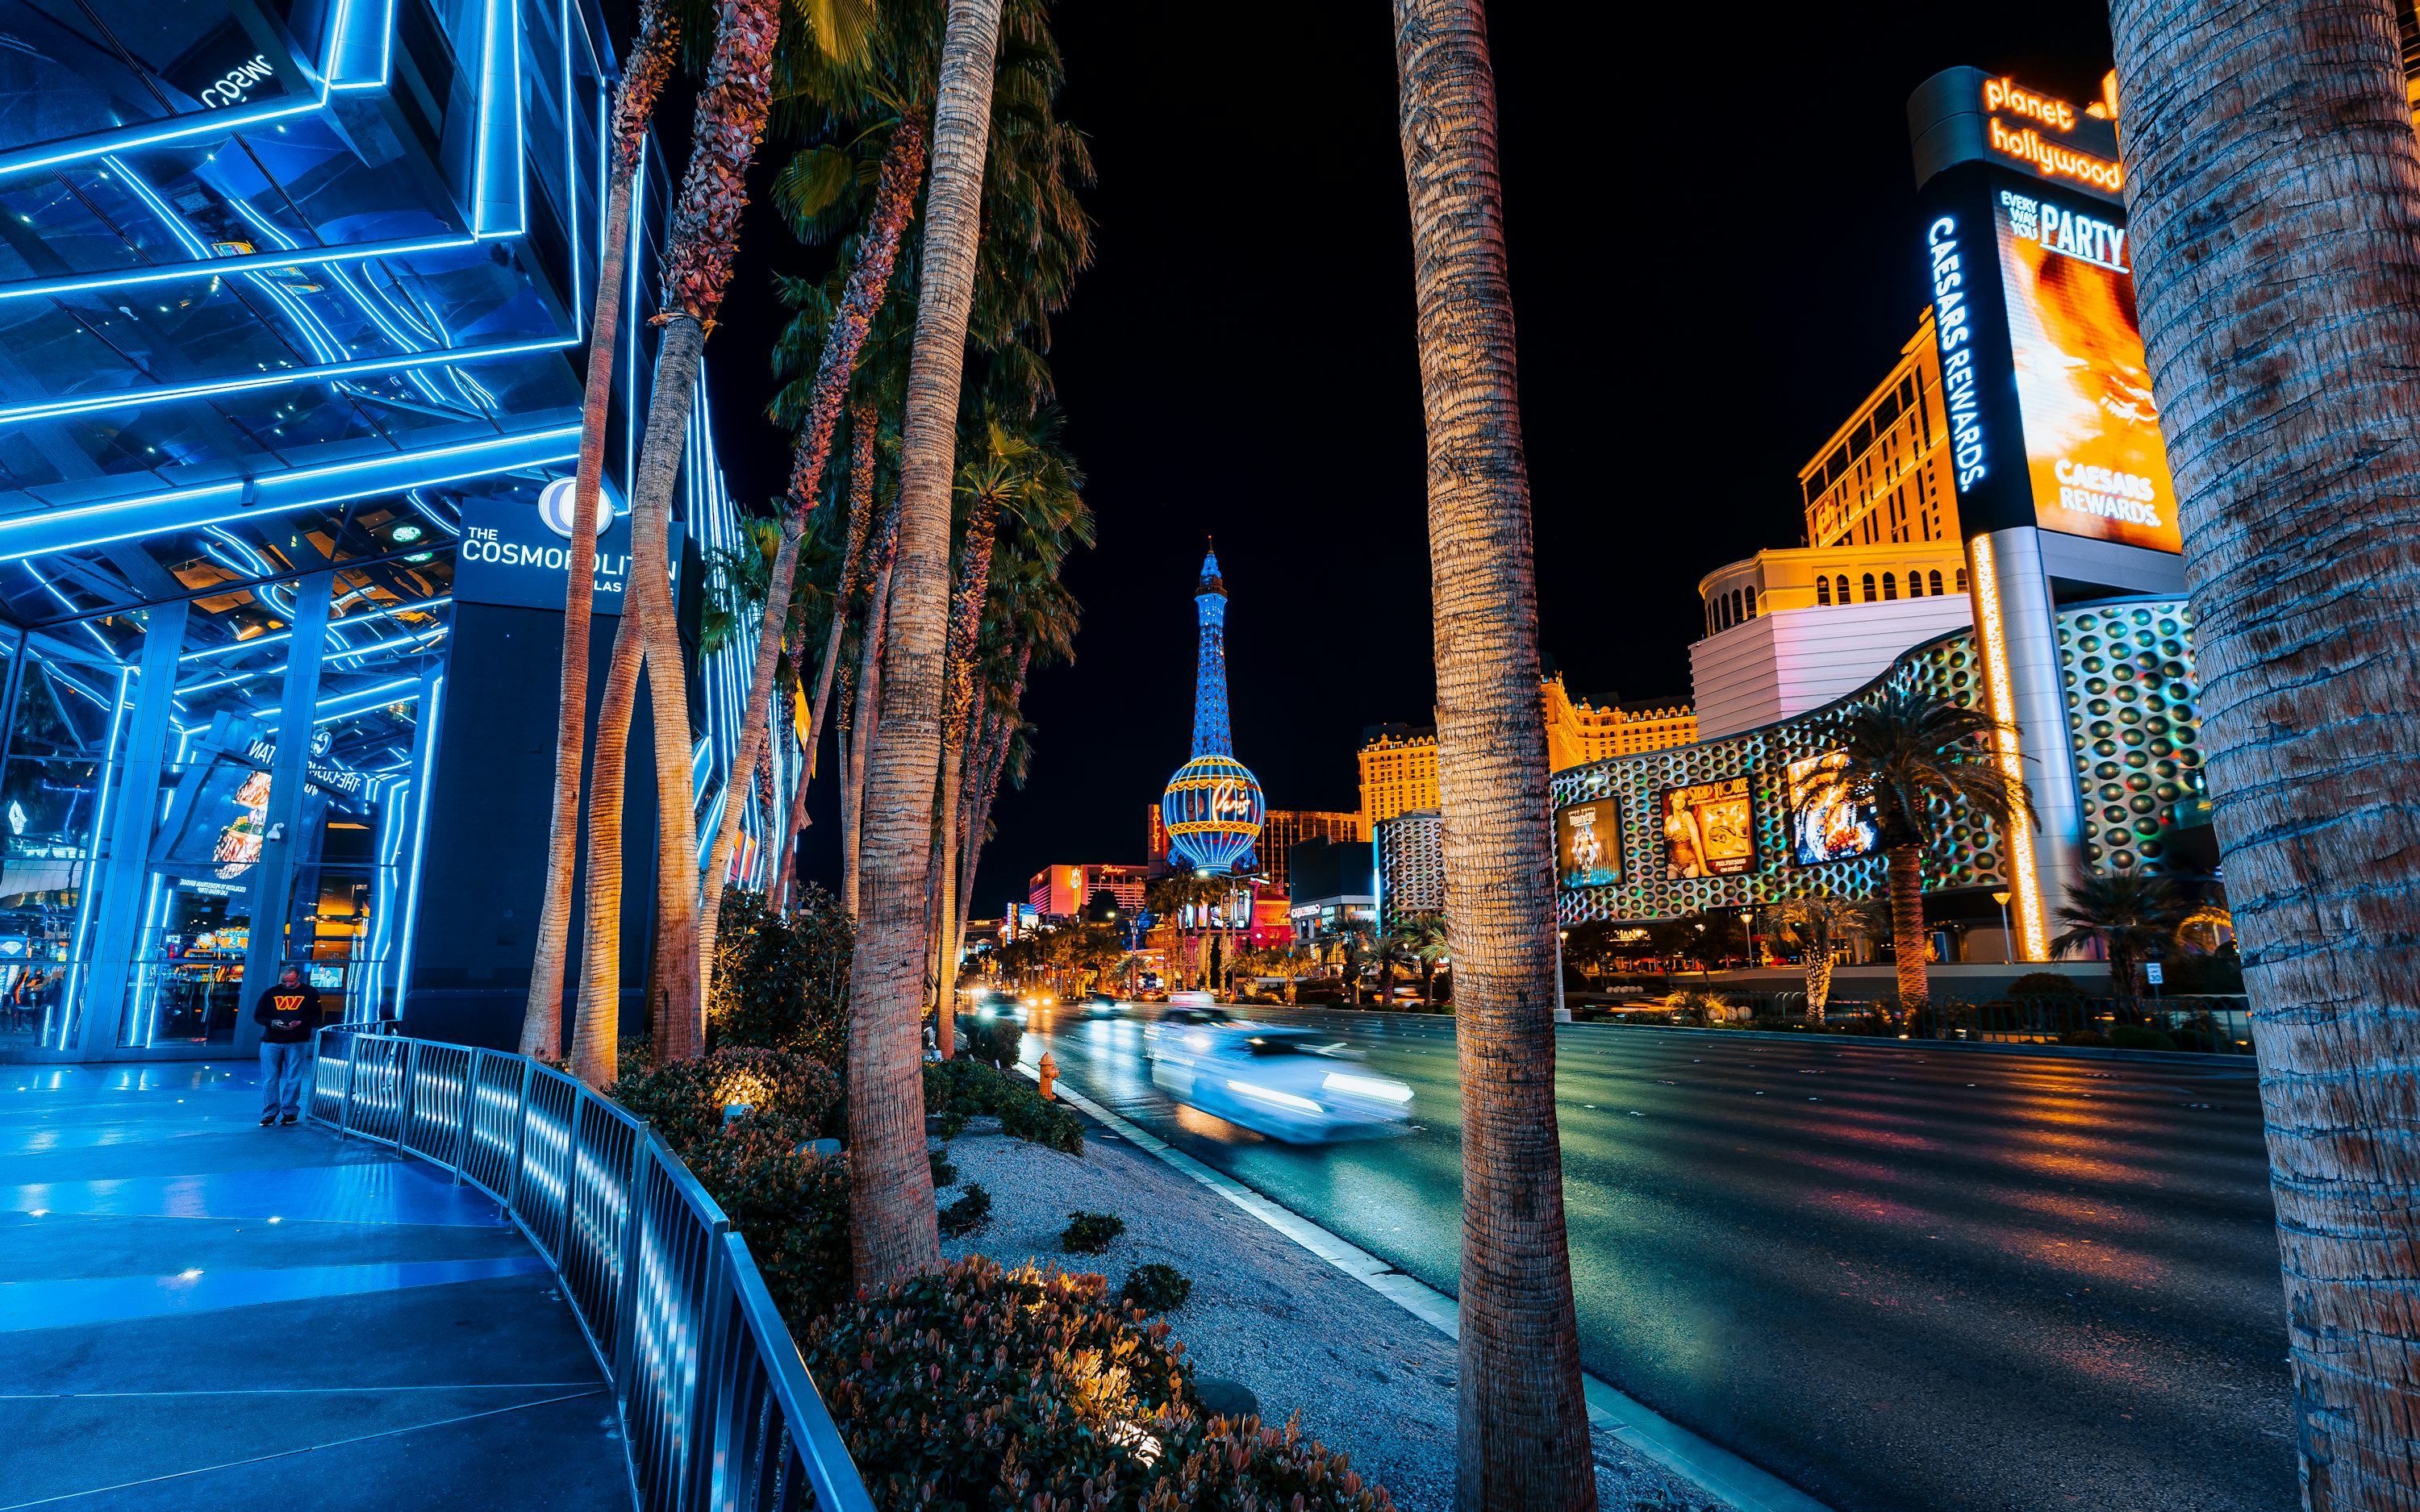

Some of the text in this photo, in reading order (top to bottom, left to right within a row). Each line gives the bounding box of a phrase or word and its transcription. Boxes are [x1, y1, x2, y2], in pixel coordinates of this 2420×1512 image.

[1985, 77, 2074, 130] planet
[1990, 117, 2122, 190] hollywood
[2001, 190, 2038, 214] EVERY
[2010, 207, 2038, 227] WAY
[2009, 220, 2038, 240] YOU
[2041, 204, 2126, 266] PARTY
[1930, 217, 1968, 352] CAESARS
[2055, 459, 2155, 502] CAESARS
[468, 527, 499, 540] THE
[594, 580, 622, 592] LAS
[1212, 778, 1251, 824] Paris
[1688, 785, 1713, 806] STRIP
[1713, 777, 1749, 801] HOUSE
